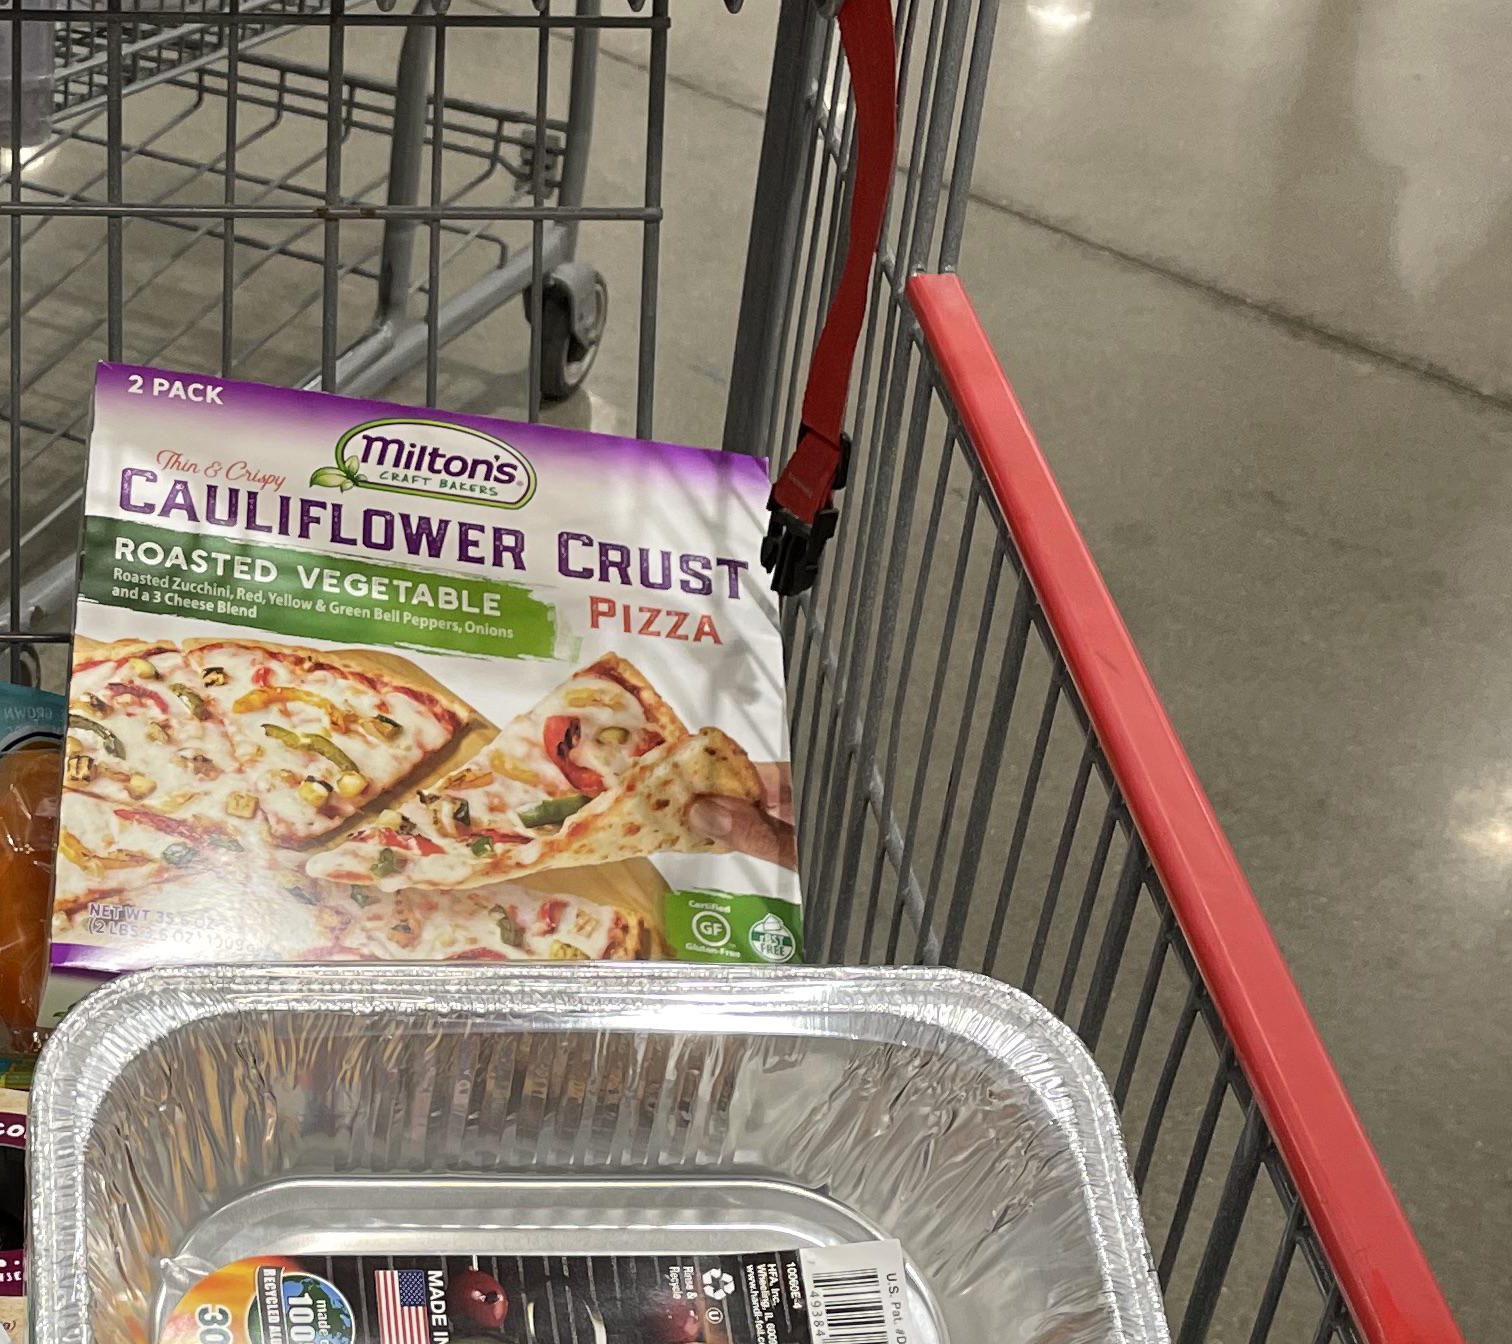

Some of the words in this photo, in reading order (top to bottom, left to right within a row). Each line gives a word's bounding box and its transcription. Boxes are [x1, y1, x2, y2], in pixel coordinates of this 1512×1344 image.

[127, 374, 144, 394] 2
[151, 376, 226, 405] PACK
[156, 449, 202, 475] Thin
[224, 459, 287, 492] Crispy
[378, 469, 435, 492] CRAFT
[437, 478, 500, 497] BAKERS
[117, 467, 527, 572] CAULIFLOWER
[557, 531, 751, 602] CRUST
[114, 536, 279, 584] ROASTED
[296, 564, 502, 618] VEGETABLE
[111, 583, 140, 599] and
[164, 592, 216, 613] Cheese
[216, 600, 259, 620] Blend
[113, 567, 170, 588] Roasted
[171, 575, 235, 600] Zucchini,
[237, 586, 267, 606] Red,
[267, 592, 314, 613] Yellow
[329, 601, 372, 621] Green
[373, 605, 401, 623] Bell
[403, 610, 464, 635] Peppers,
[464, 618, 516, 641] Onions
[588, 594, 725, 646] PIZZA
[88, 902, 122, 921] NET
[699, 921, 724, 936] GF
[261, 1267, 282, 1325] RECYCLED
[427, 1269, 449, 1325] MADE
[886, 1272, 901, 1299] U.S.
[809, 1290, 826, 1338] 49384
